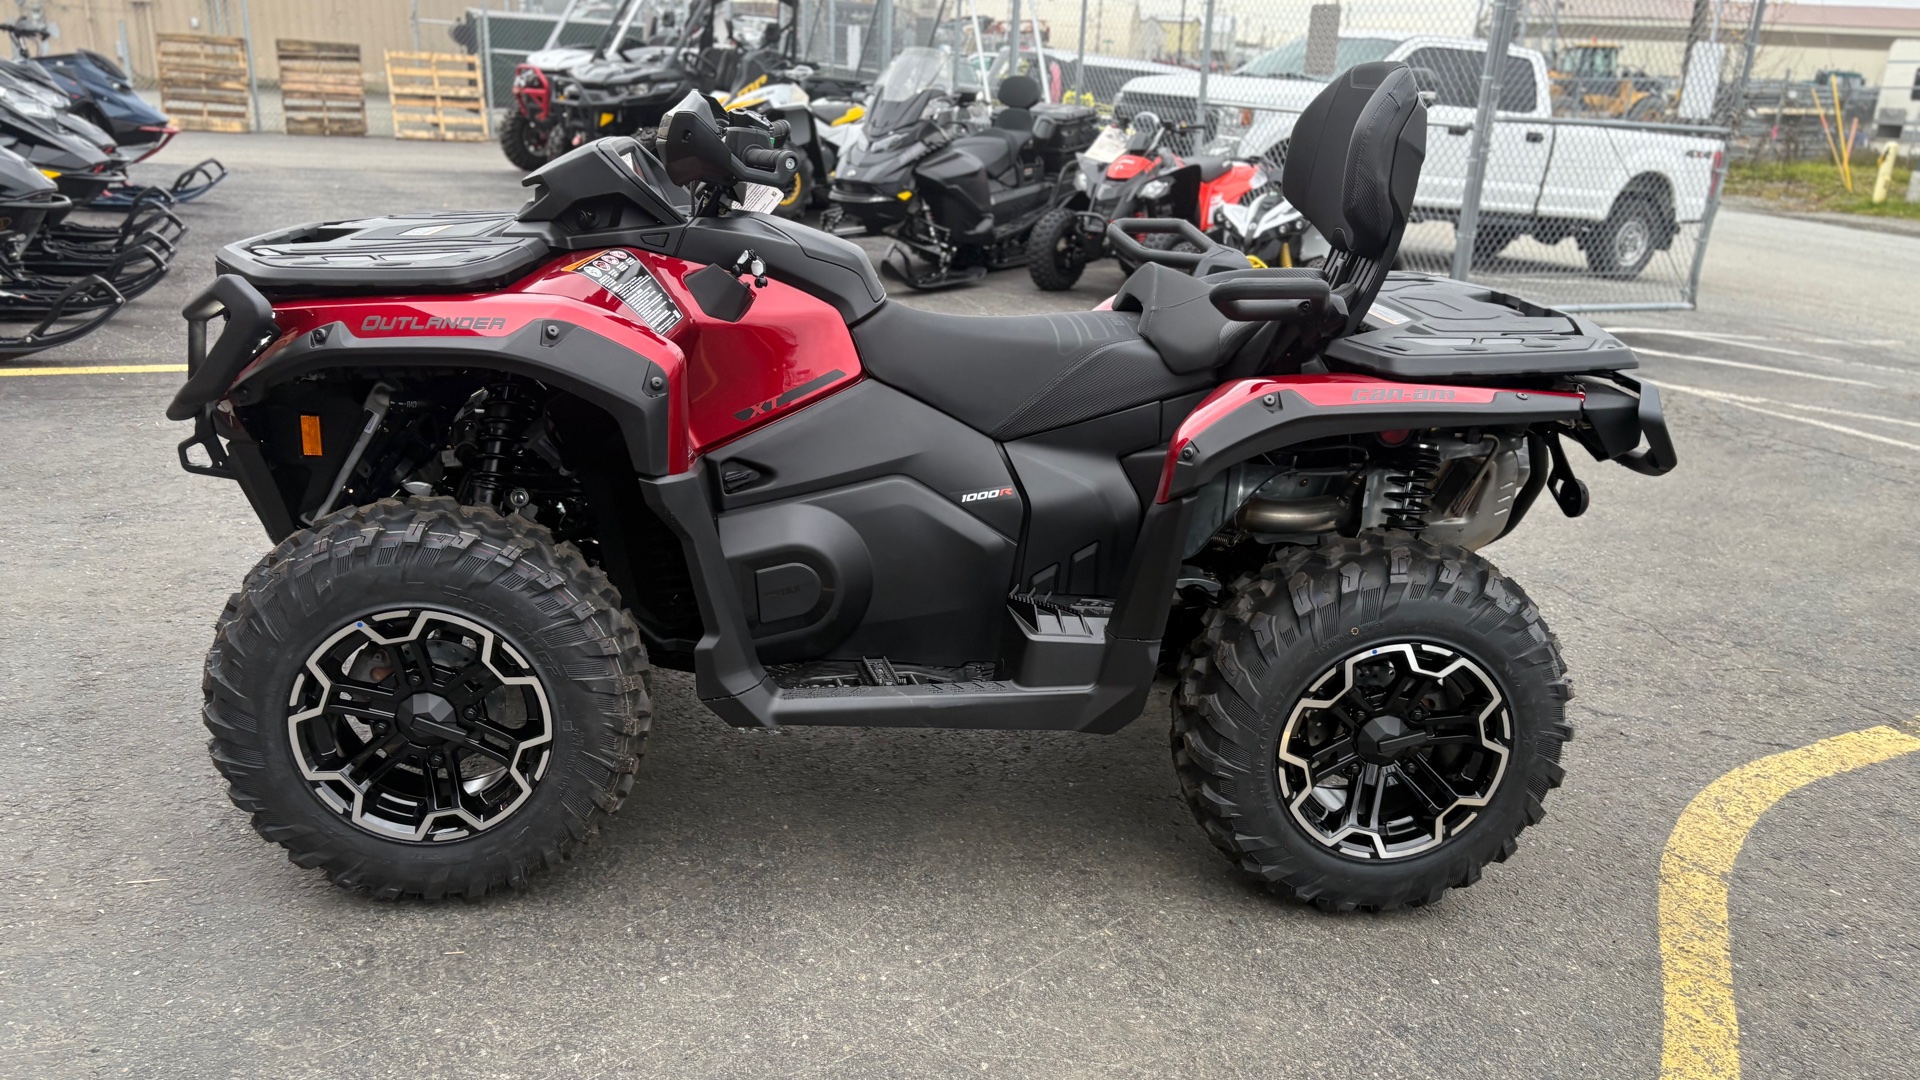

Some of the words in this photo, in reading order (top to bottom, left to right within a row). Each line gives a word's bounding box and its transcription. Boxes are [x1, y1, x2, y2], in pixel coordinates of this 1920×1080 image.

[361, 315, 507, 331] OUTLANDER
[1351, 388, 1456, 401] can-am
[748, 394, 783, 419] XT
[961, 488, 1013, 503] 1000R
